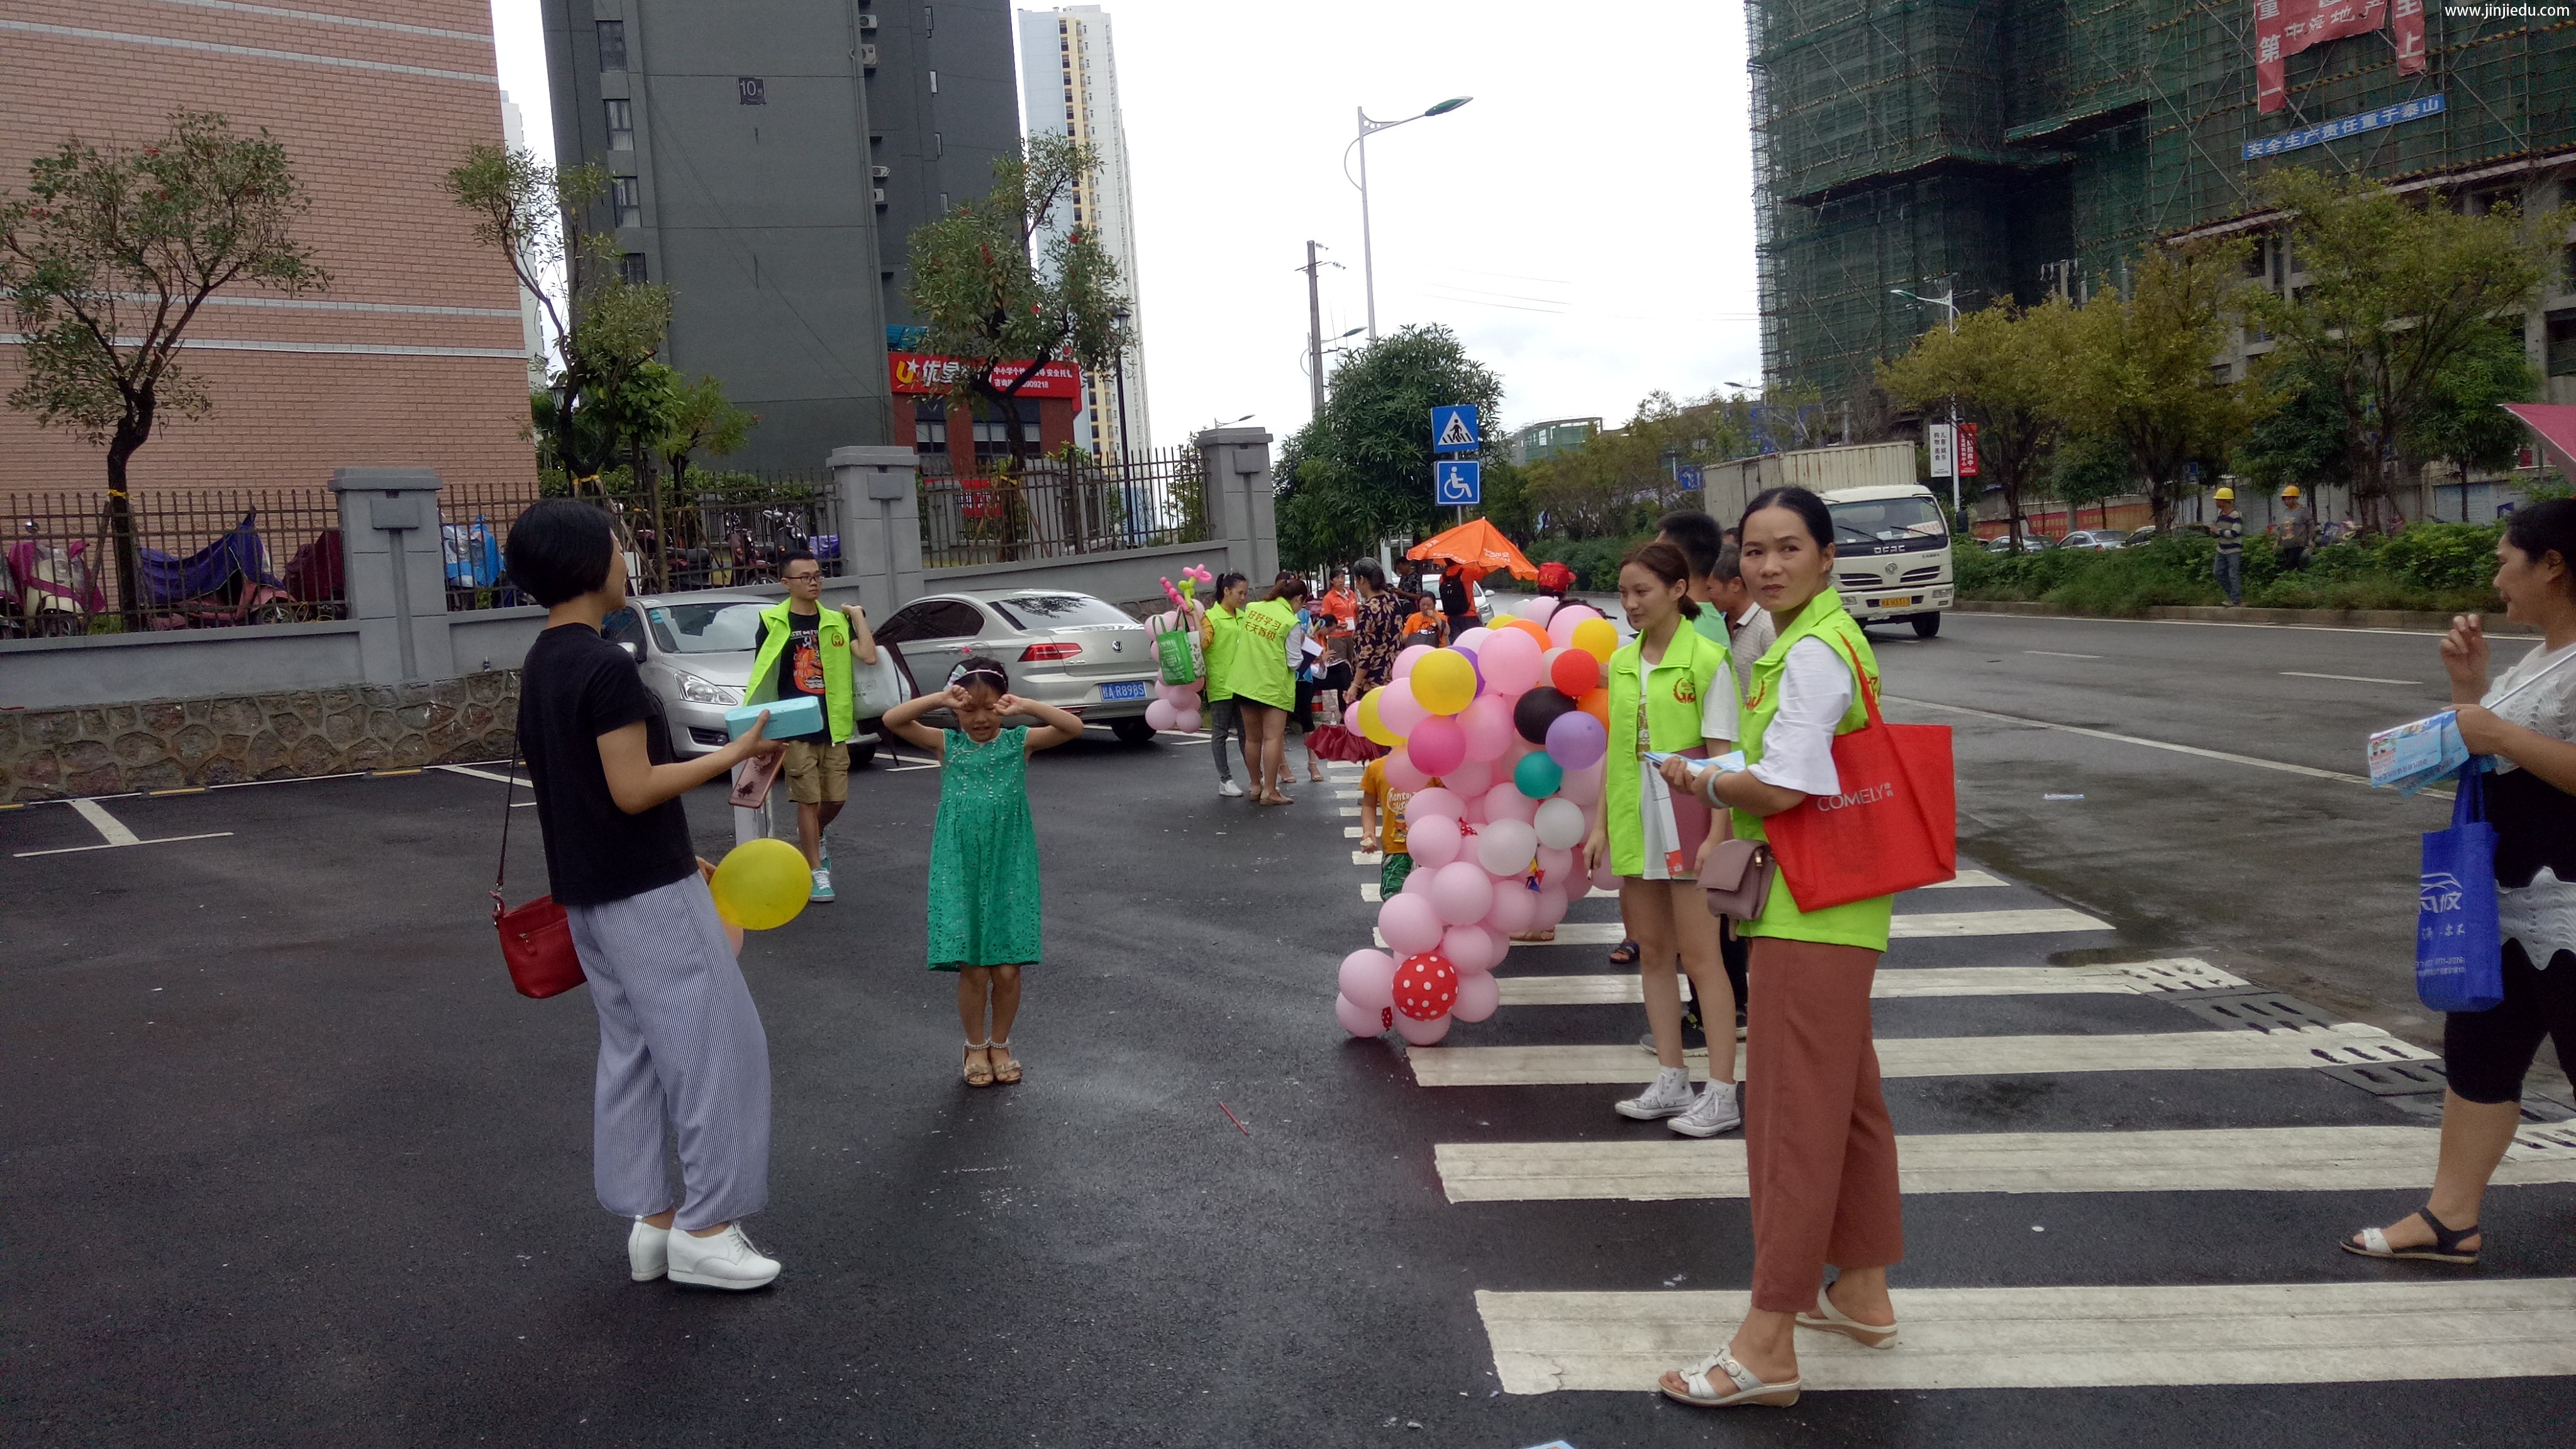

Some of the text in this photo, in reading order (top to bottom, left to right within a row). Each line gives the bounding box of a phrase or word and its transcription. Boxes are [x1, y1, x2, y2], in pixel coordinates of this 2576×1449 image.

[2248, 99, 2439, 157] 安全生产责任重于泰山
[1816, 784, 1884, 812] COMELY
